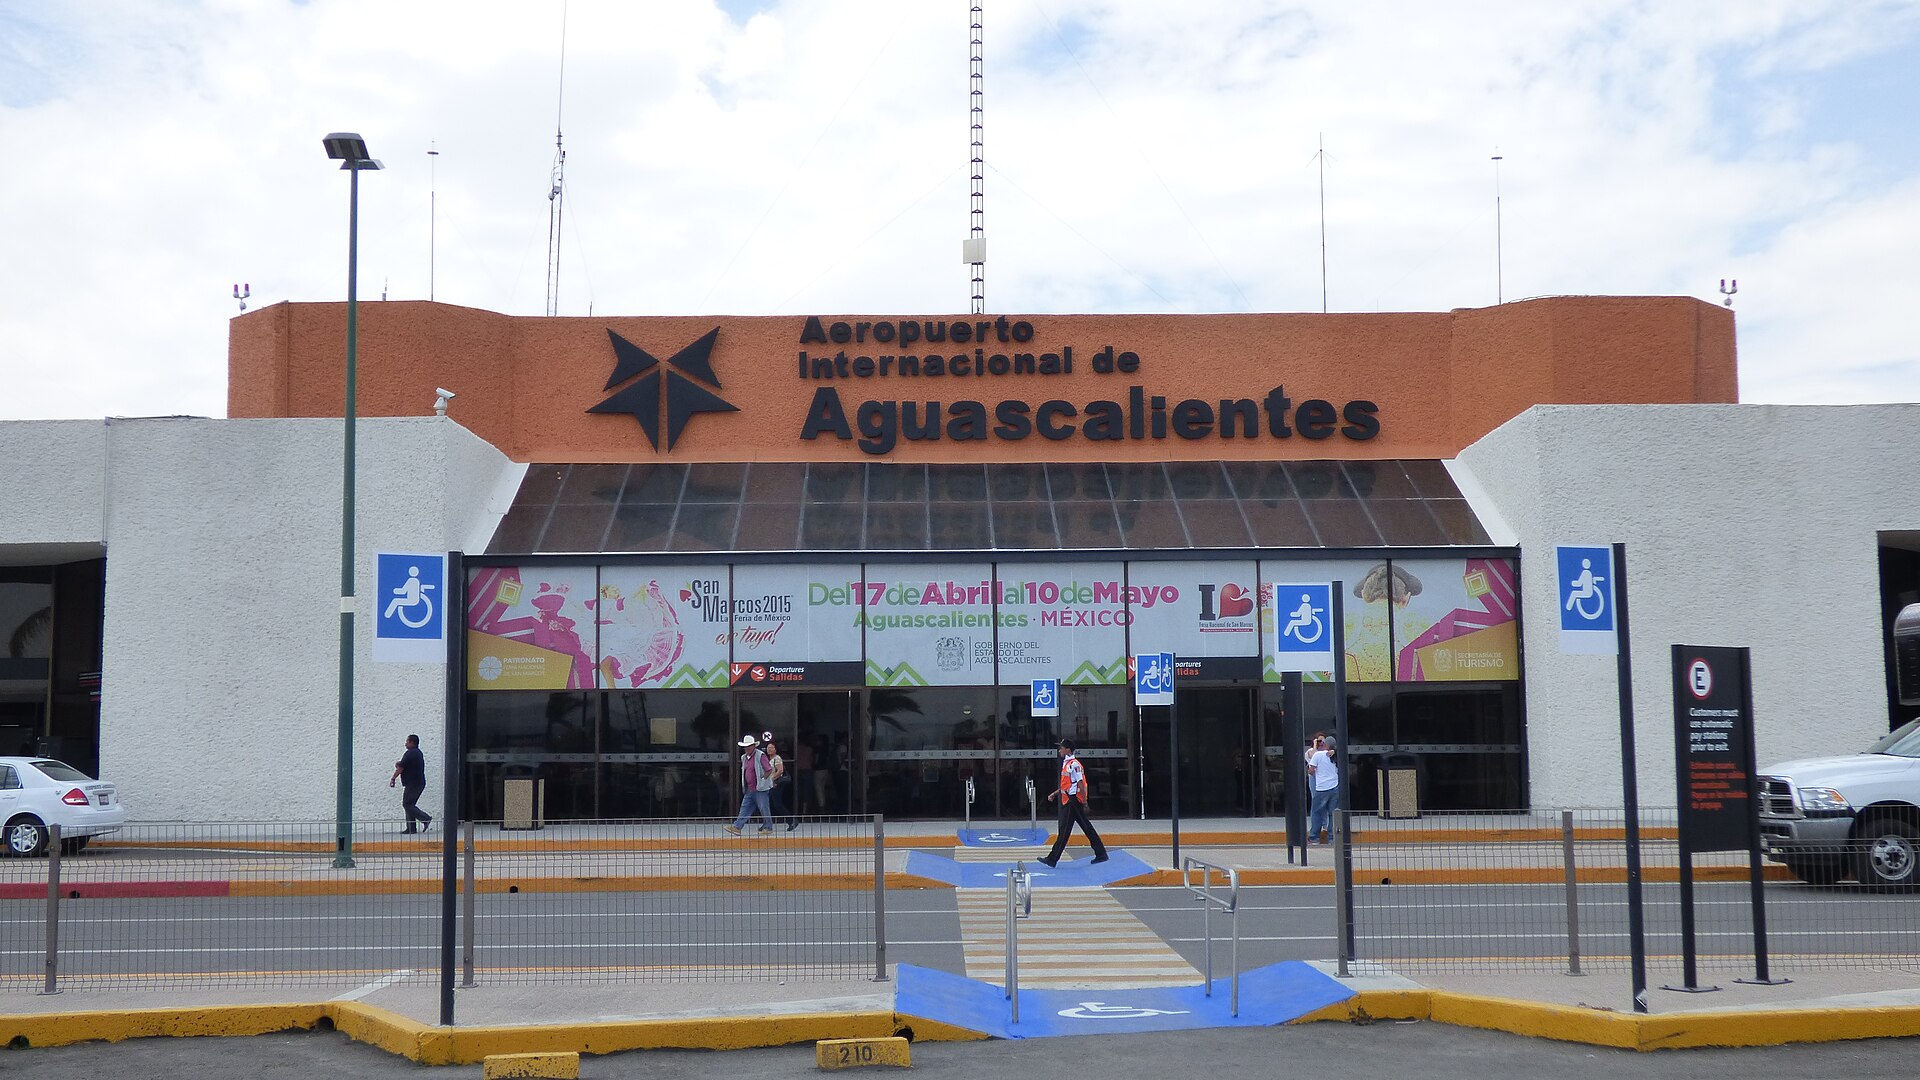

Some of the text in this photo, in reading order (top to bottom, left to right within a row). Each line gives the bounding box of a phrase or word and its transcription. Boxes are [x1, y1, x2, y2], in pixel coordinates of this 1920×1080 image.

[799, 315, 1035, 348] Aeropuerto
[799, 346, 1141, 379] Internacional de
[800, 384, 1381, 456] Aguascalientes
[691, 580, 720, 609] San
[734, 614, 753, 622] Feria
[753, 614, 763, 622] de
[764, 613, 791, 622] México
[852, 606, 1135, 632] Aguascalientes MÉXICO
[769, 666, 805, 674] Departures
[1175, 661, 1202, 669] partures
[1177, 668, 1200, 676] lidas
[1458, 659, 1504, 668] TURISMO
[769, 673, 804, 681] Salidas
[1695, 667, 1706, 690] E
[839, 1045, 873, 1064] 210
